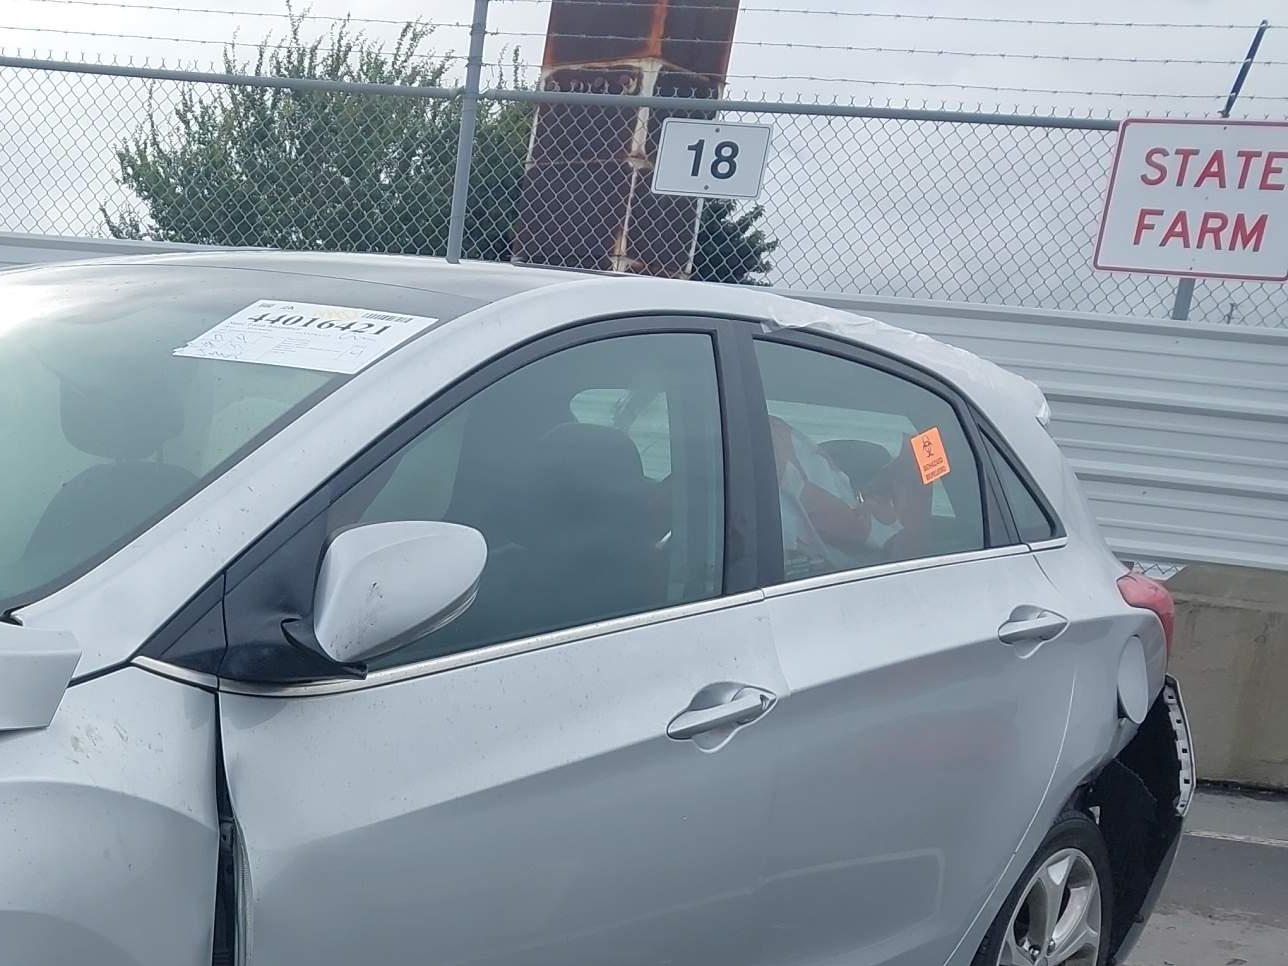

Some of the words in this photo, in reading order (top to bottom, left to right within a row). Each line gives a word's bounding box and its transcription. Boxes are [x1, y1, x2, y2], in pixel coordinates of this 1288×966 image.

[687, 139, 739, 180] 18
[1140, 147, 1288, 191] STATE
[1133, 208, 1269, 252] FARM
[248, 312, 392, 335] 44016421
